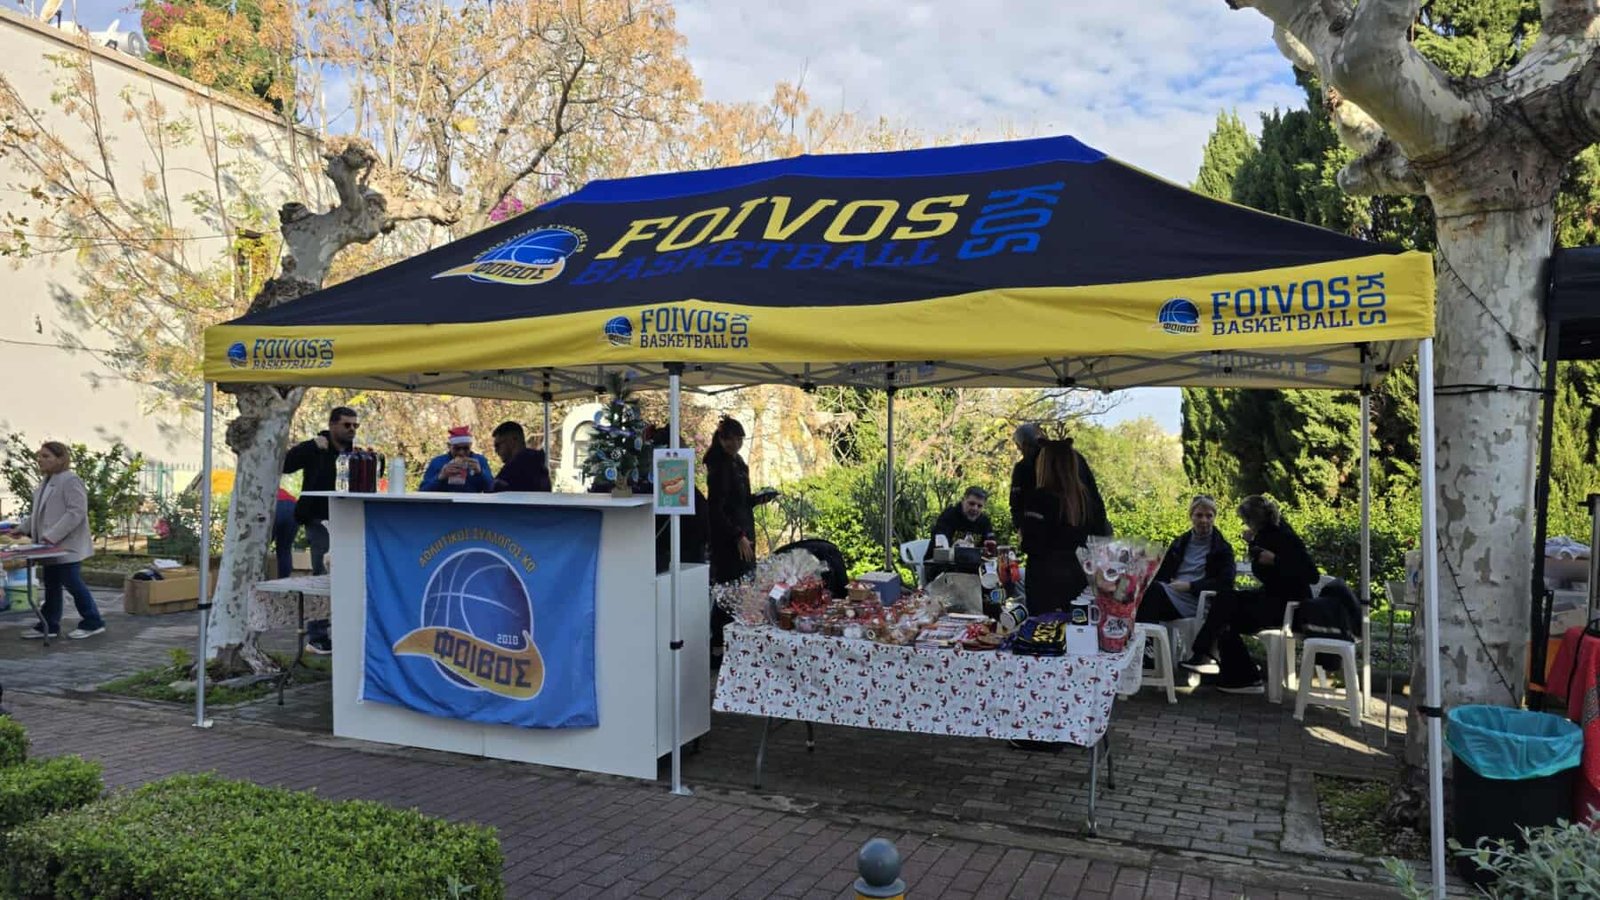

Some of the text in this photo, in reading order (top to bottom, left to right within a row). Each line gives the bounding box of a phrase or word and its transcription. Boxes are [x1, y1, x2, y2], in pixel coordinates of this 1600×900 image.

[594, 194, 969, 259] FOIVOS
[957, 182, 1065, 260] KOS
[569, 239, 939, 285] BASKETBALL
[1211, 276, 1351, 320] FOIVOS
[1356, 272, 1386, 326] KOS
[640, 307, 729, 333] FOIVOS
[730, 313, 751, 348] KOS
[1212, 310, 1353, 335] BASKETBALL
[253, 338, 320, 358] FOIVOS
[640, 333, 728, 348] BASKETBALL
[253, 359, 317, 369] BASKETBALL
[496, 633, 519, 645] 2010
[433, 631, 532, 688] ΦΟΙΒΟΣ
